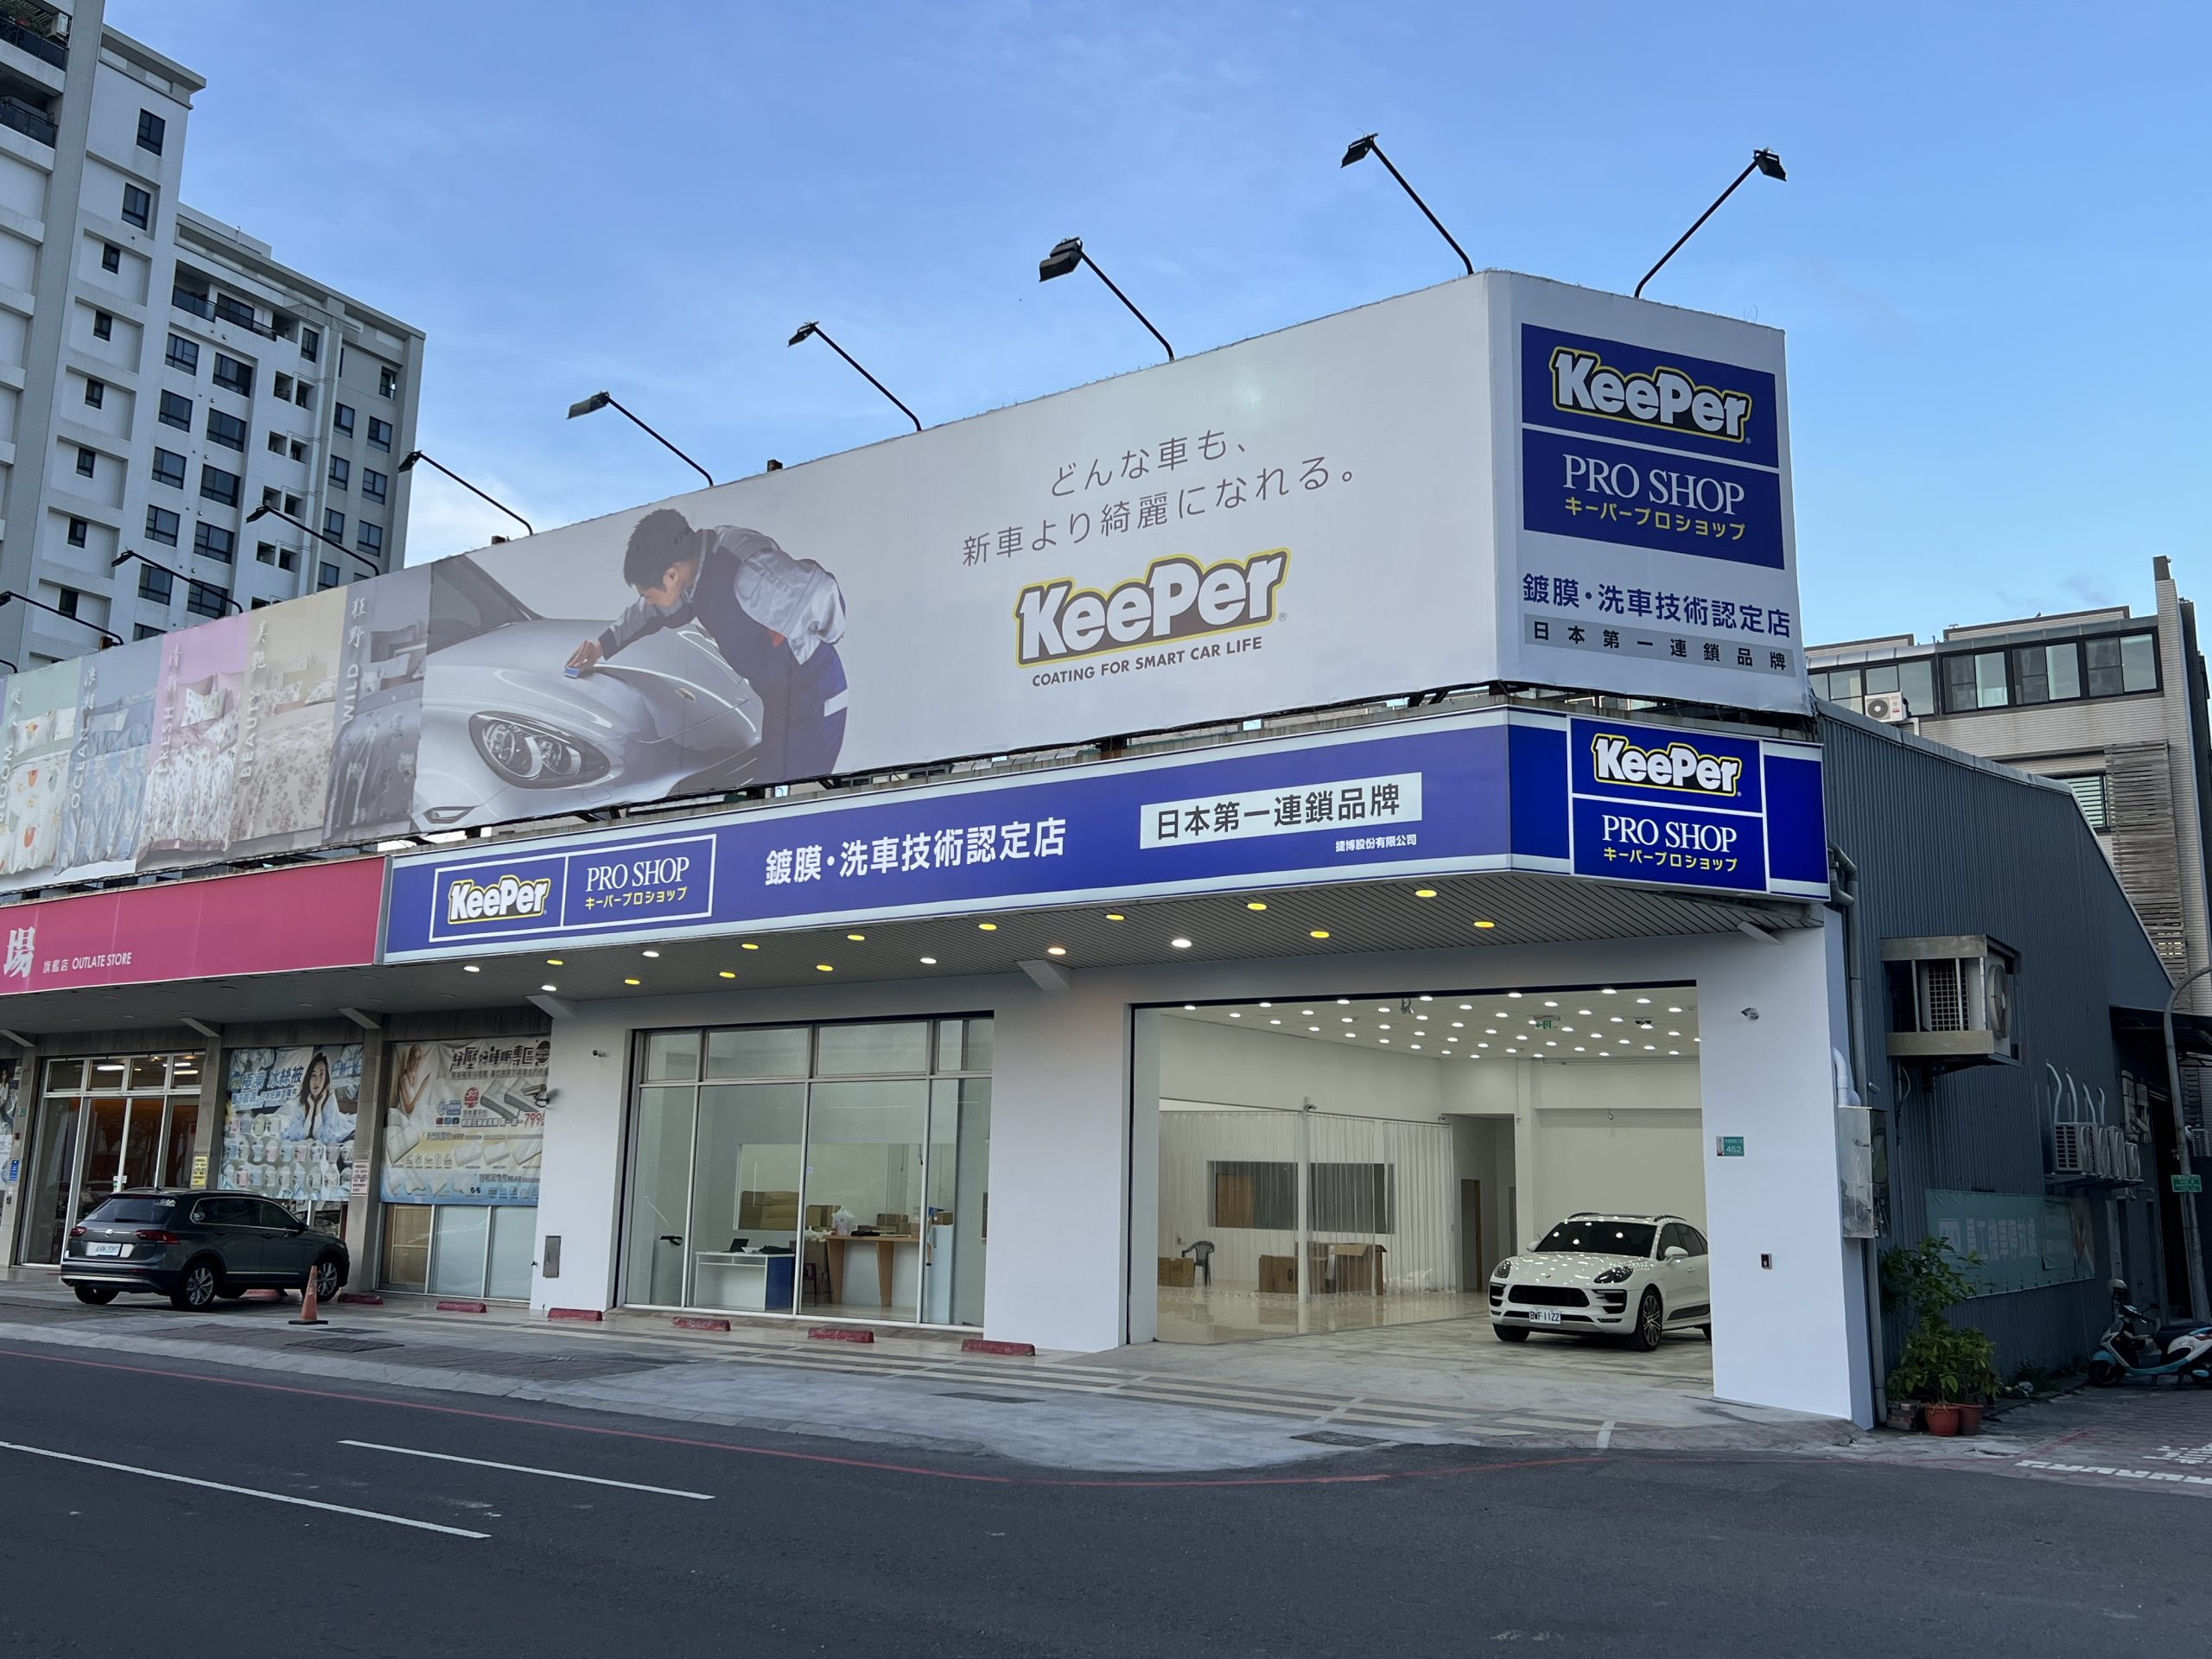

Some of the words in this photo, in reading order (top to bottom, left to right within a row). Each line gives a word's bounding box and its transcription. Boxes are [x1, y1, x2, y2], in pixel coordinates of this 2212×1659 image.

[1552, 349, 1750, 441] KeePer
[1052, 429, 1246, 497] どんな車も、
[1563, 454, 1640, 499] PRO
[1649, 468, 1745, 516] SHOP
[963, 455, 1353, 567] 新車より綺麗になれる。
[1565, 496, 1745, 541] キーパープロショップ
[1016, 550, 1287, 665] KeePer
[1032, 665, 1096, 687] COATING
[1101, 658, 1129, 676] FOR
[1135, 650, 1185, 671] SMART
[1191, 643, 1220, 661] CAR
[1227, 636, 1262, 654] LIFE
[342, 663, 359, 724] WILD
[158, 706, 175, 773] FRESH
[241, 690, 259, 779] BEAUTY
[72, 728, 89, 809] OCEAN
[1593, 735, 1739, 794] KeePer
[1158, 783, 1400, 840] 日本第一連鎖品牌
[1601, 814, 1659, 846] PRO
[1665, 821, 1737, 853] SHOP
[1335, 834, 1417, 852] 捷博股份有限公司
[1604, 847, 1738, 872] キーパープロショップ
[448, 875, 549, 923] KeePer
[585, 887, 688, 910] キーパープロショップ
[587, 865, 629, 893] PRO
[632, 856, 690, 887] SHOP
[72, 955, 105, 969] OUTLATE
[107, 952, 131, 967] STORE
